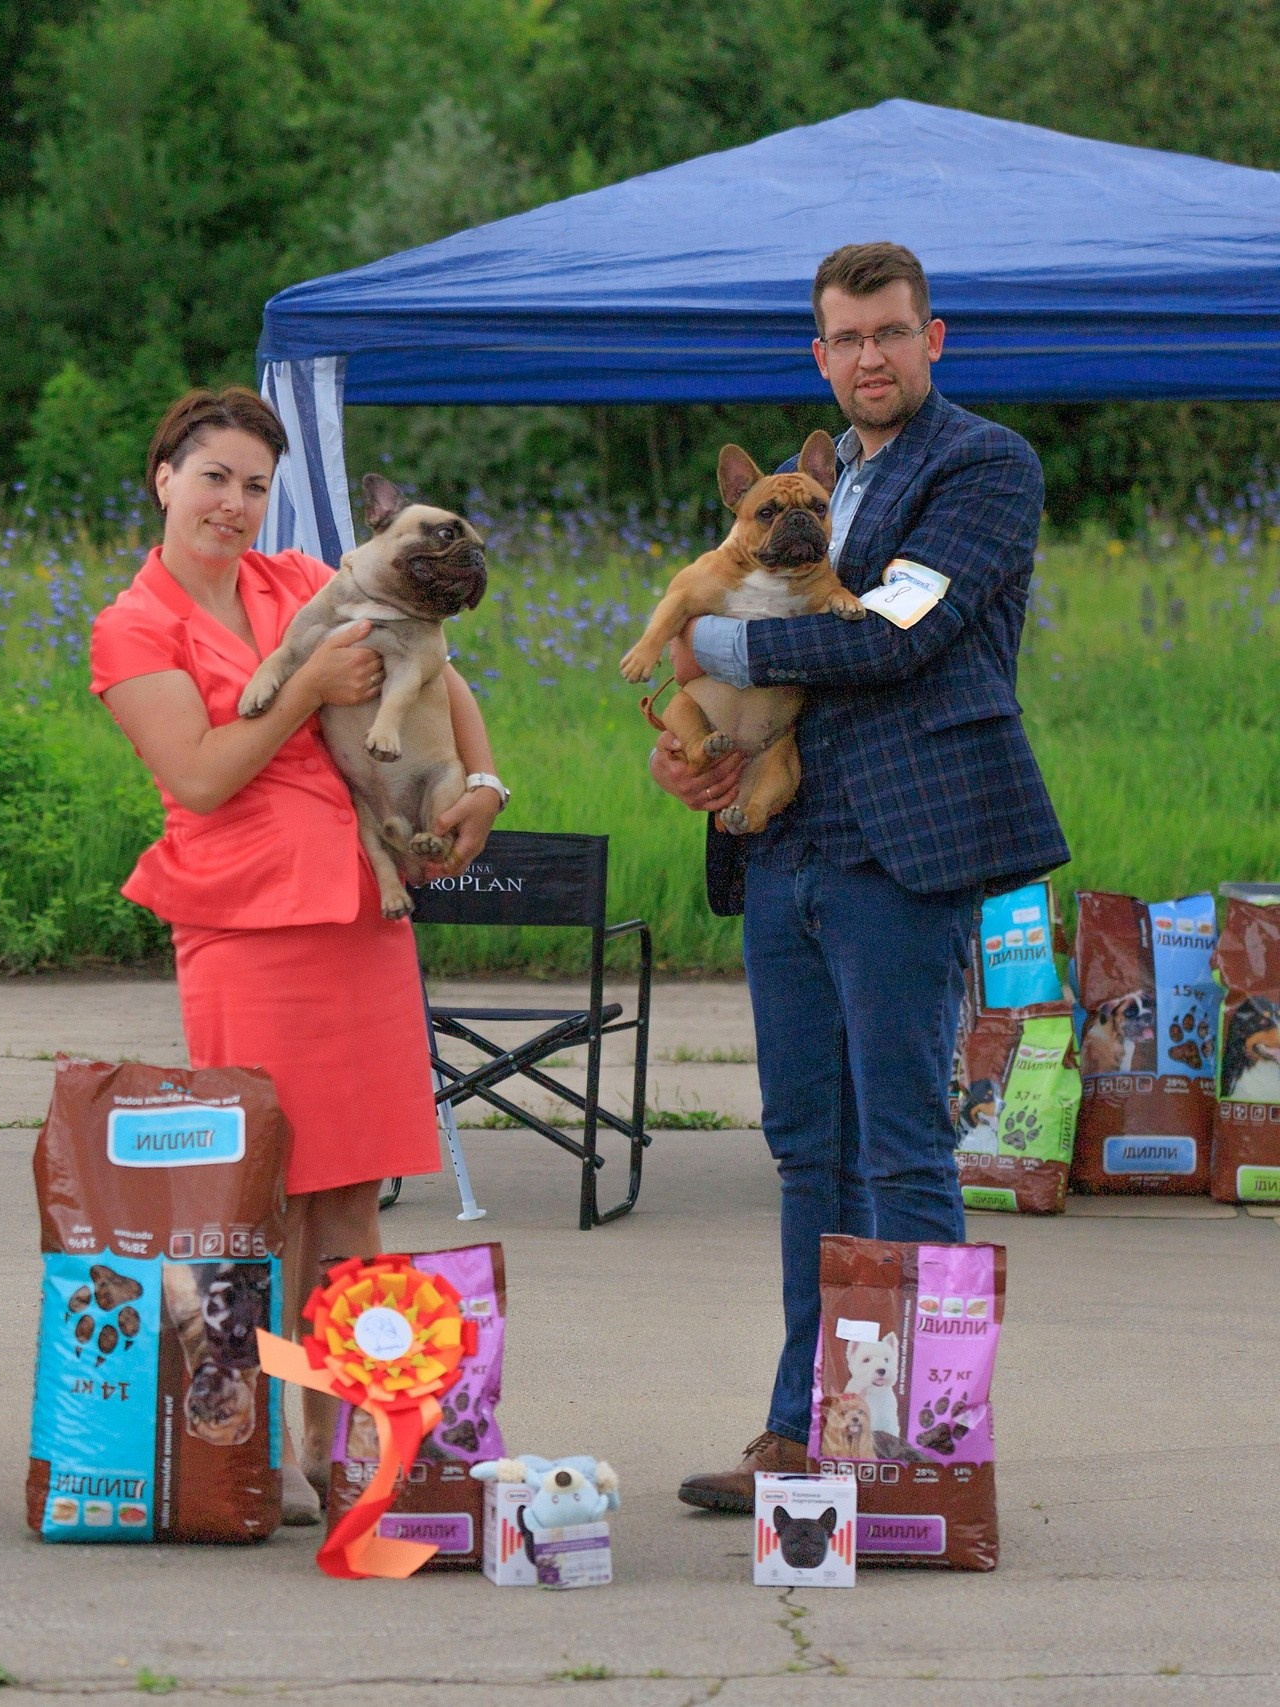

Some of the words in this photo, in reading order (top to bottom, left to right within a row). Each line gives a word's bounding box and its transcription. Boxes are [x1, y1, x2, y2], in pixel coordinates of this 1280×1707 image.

[135, 1130, 216, 1151] ДИЛЛИ
[1123, 1147, 1178, 1160] ДИЛЛИ
[917, 1317, 988, 1335] ДИЛЛИ
[928, 1368, 952, 1384] 3,7
[956, 1370, 973, 1381] кг
[71, 1380, 94, 1395] кг
[102, 1381, 130, 1401] 14
[55, 1474, 147, 1500] ДИЛЛИ
[866, 1525, 928, 1539] ДИЛЛИ
